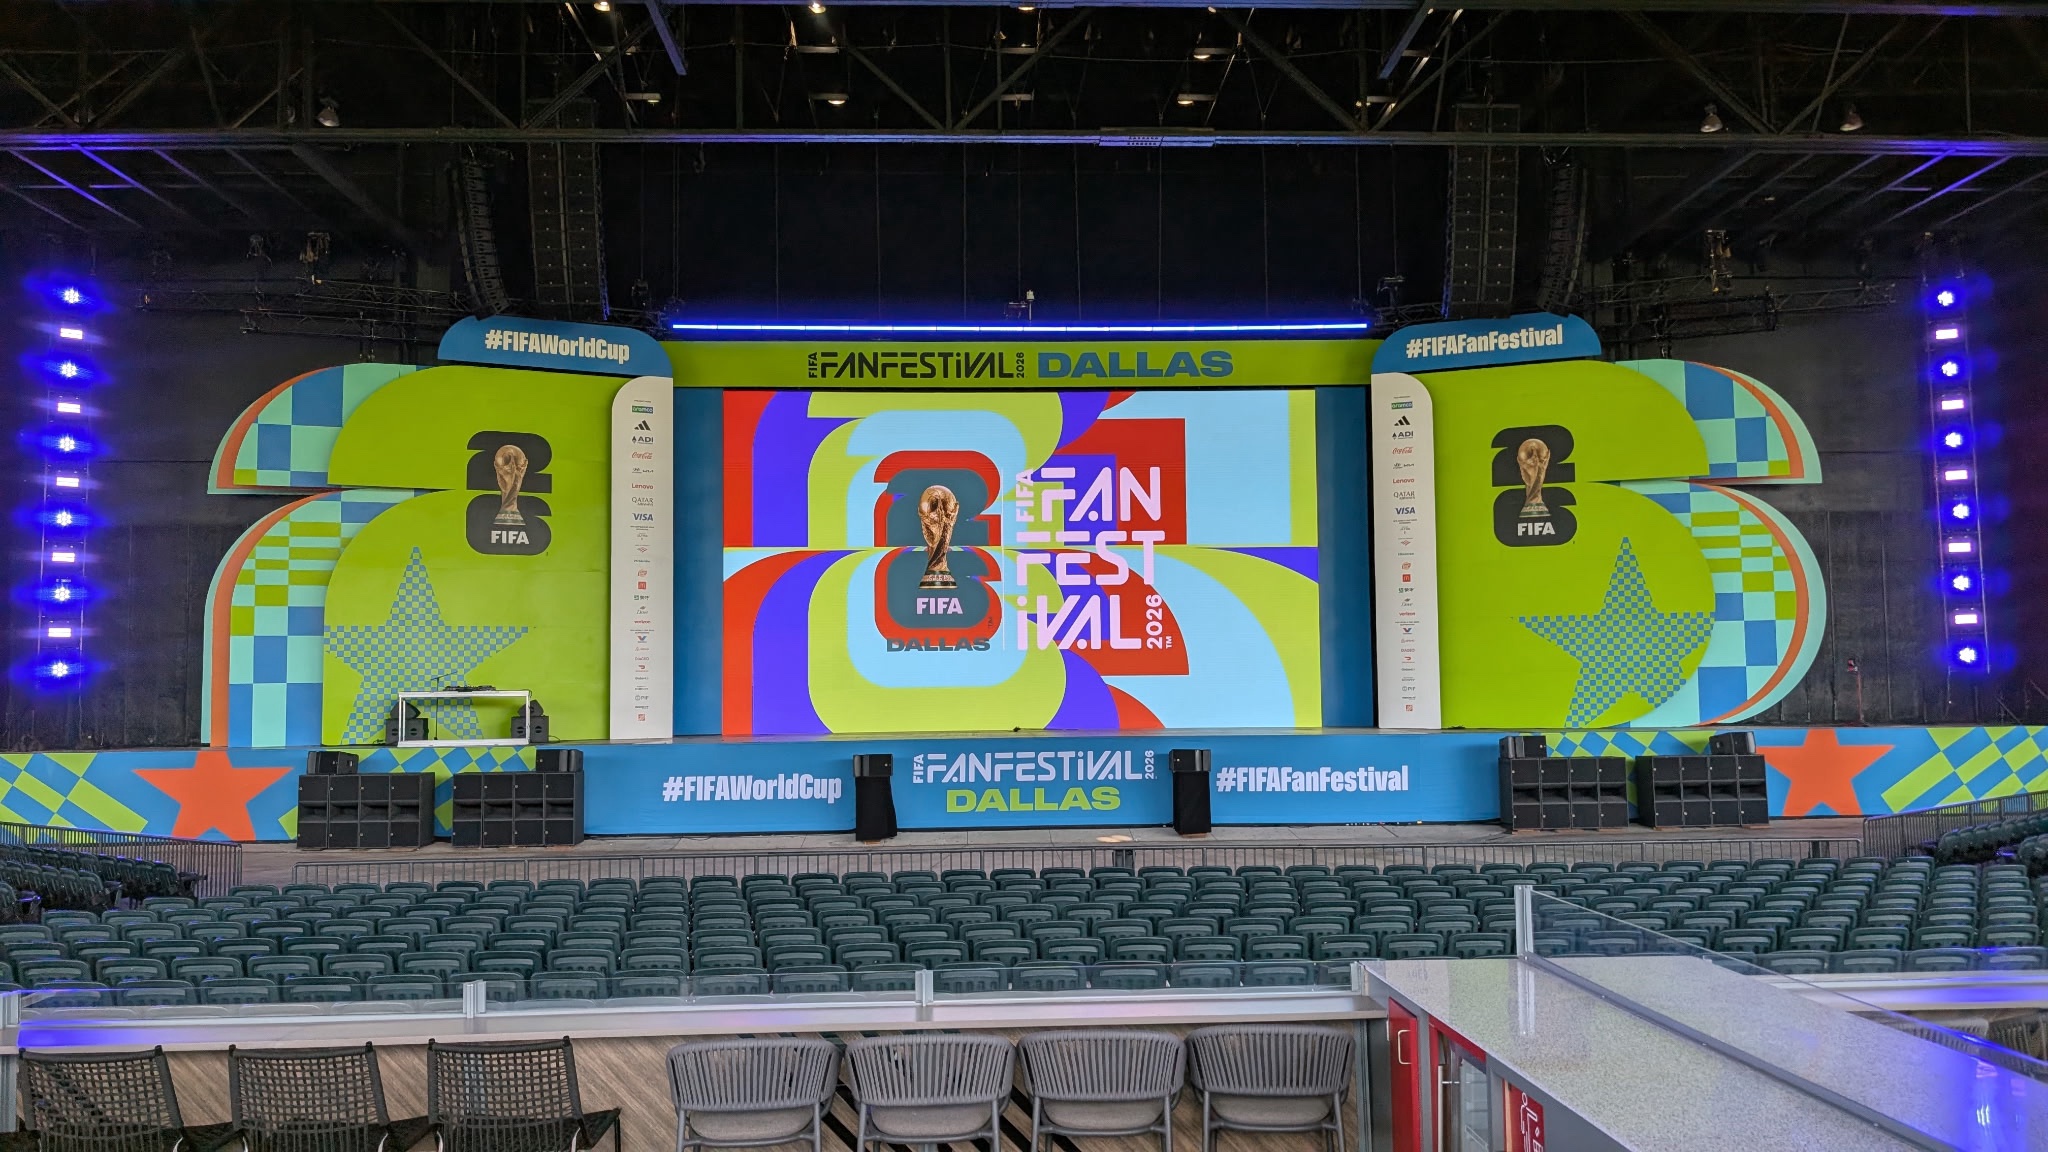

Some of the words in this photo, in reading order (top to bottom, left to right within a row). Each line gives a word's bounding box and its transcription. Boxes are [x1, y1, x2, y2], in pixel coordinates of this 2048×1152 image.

[485, 329, 630, 364] #FIFAWorldCup
[1406, 323, 1563, 359] #FIFAFanFestival
[808, 351, 818, 378] FIFA
[1016, 352, 1025, 379] 2026
[1038, 350, 1234, 378] DALLAS
[1016, 469, 1035, 522] FIFA
[1040, 466, 1161, 522] FAN
[1393, 490, 1415, 498] QATAR
[632, 512, 654, 521] VISA
[1395, 506, 1416, 515] VISA
[490, 530, 530, 545] FIFA
[1517, 521, 1556, 537] FIFA
[1016, 530, 1165, 586] FEST
[916, 597, 963, 615] FIFA
[1145, 594, 1163, 650] 2026
[886, 637, 991, 652] DALLAS
[913, 754, 924, 783] FIFA
[1145, 750, 1155, 779] 2026
[1216, 765, 1409, 793] #FIFAFanFestival
[662, 773, 842, 804] #FIFAWorldCup
[946, 786, 1121, 812] DALLAS
